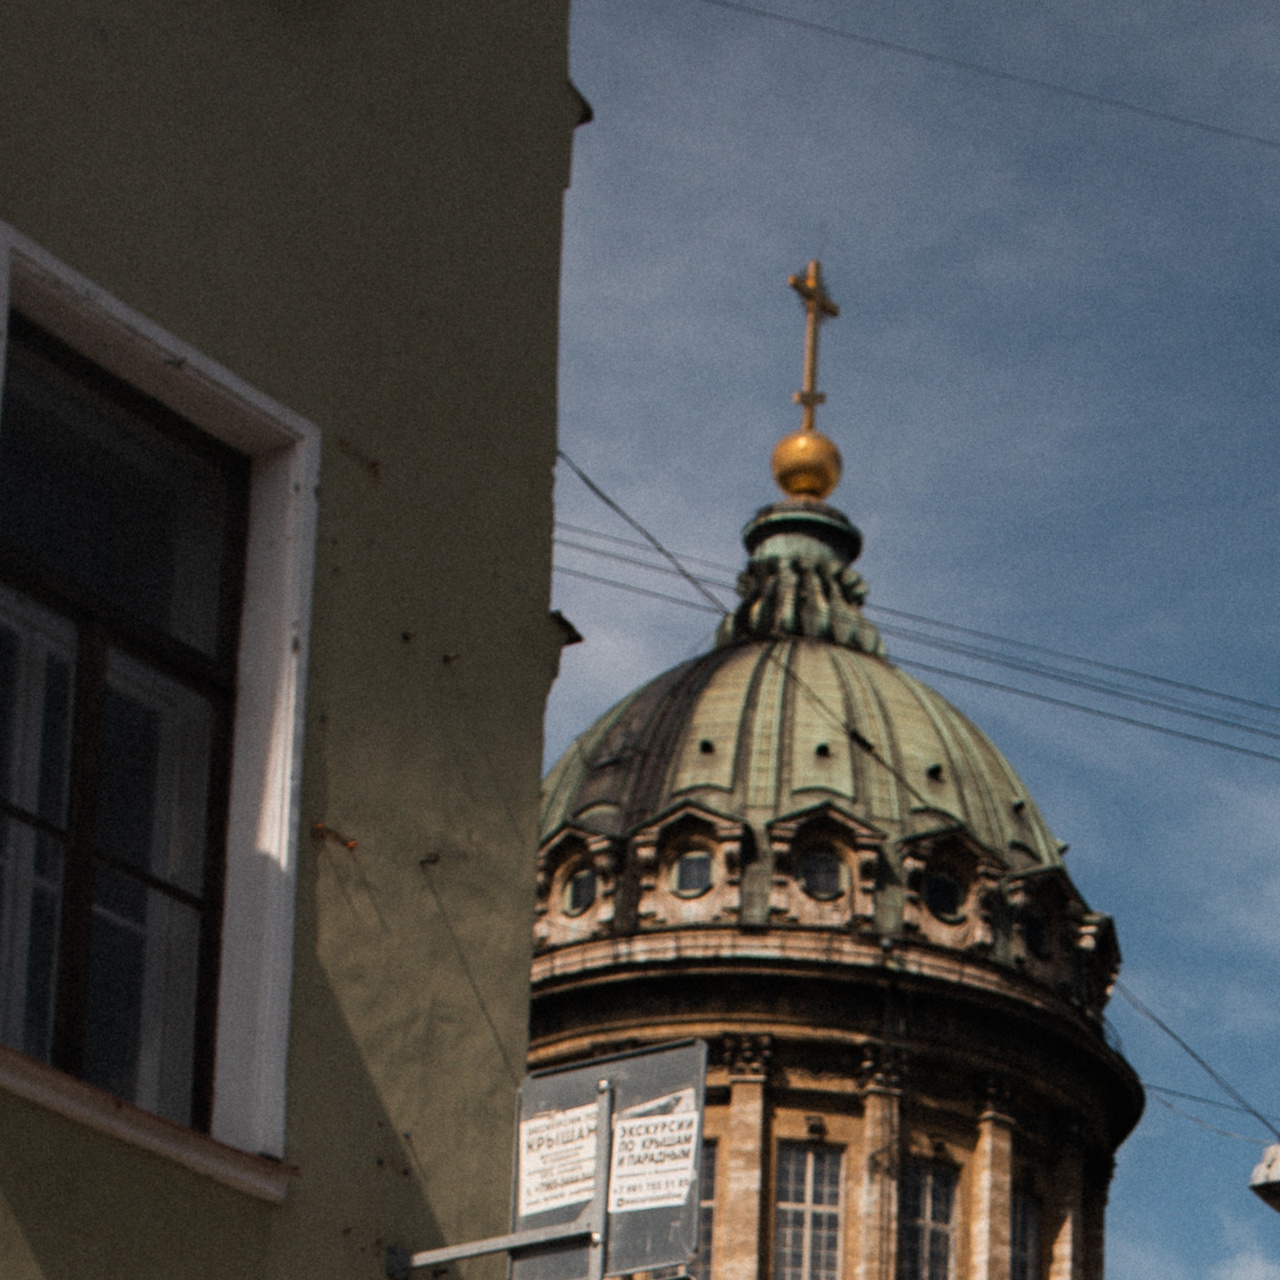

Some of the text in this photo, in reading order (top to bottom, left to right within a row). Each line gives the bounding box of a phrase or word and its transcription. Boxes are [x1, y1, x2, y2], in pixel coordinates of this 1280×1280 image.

[620, 1119, 694, 1139] ЭКСКУРСИИ
[619, 1133, 693, 1152] ПО КРЫШАМ
[627, 1148, 692, 1165] ПАРАДНЫМ
